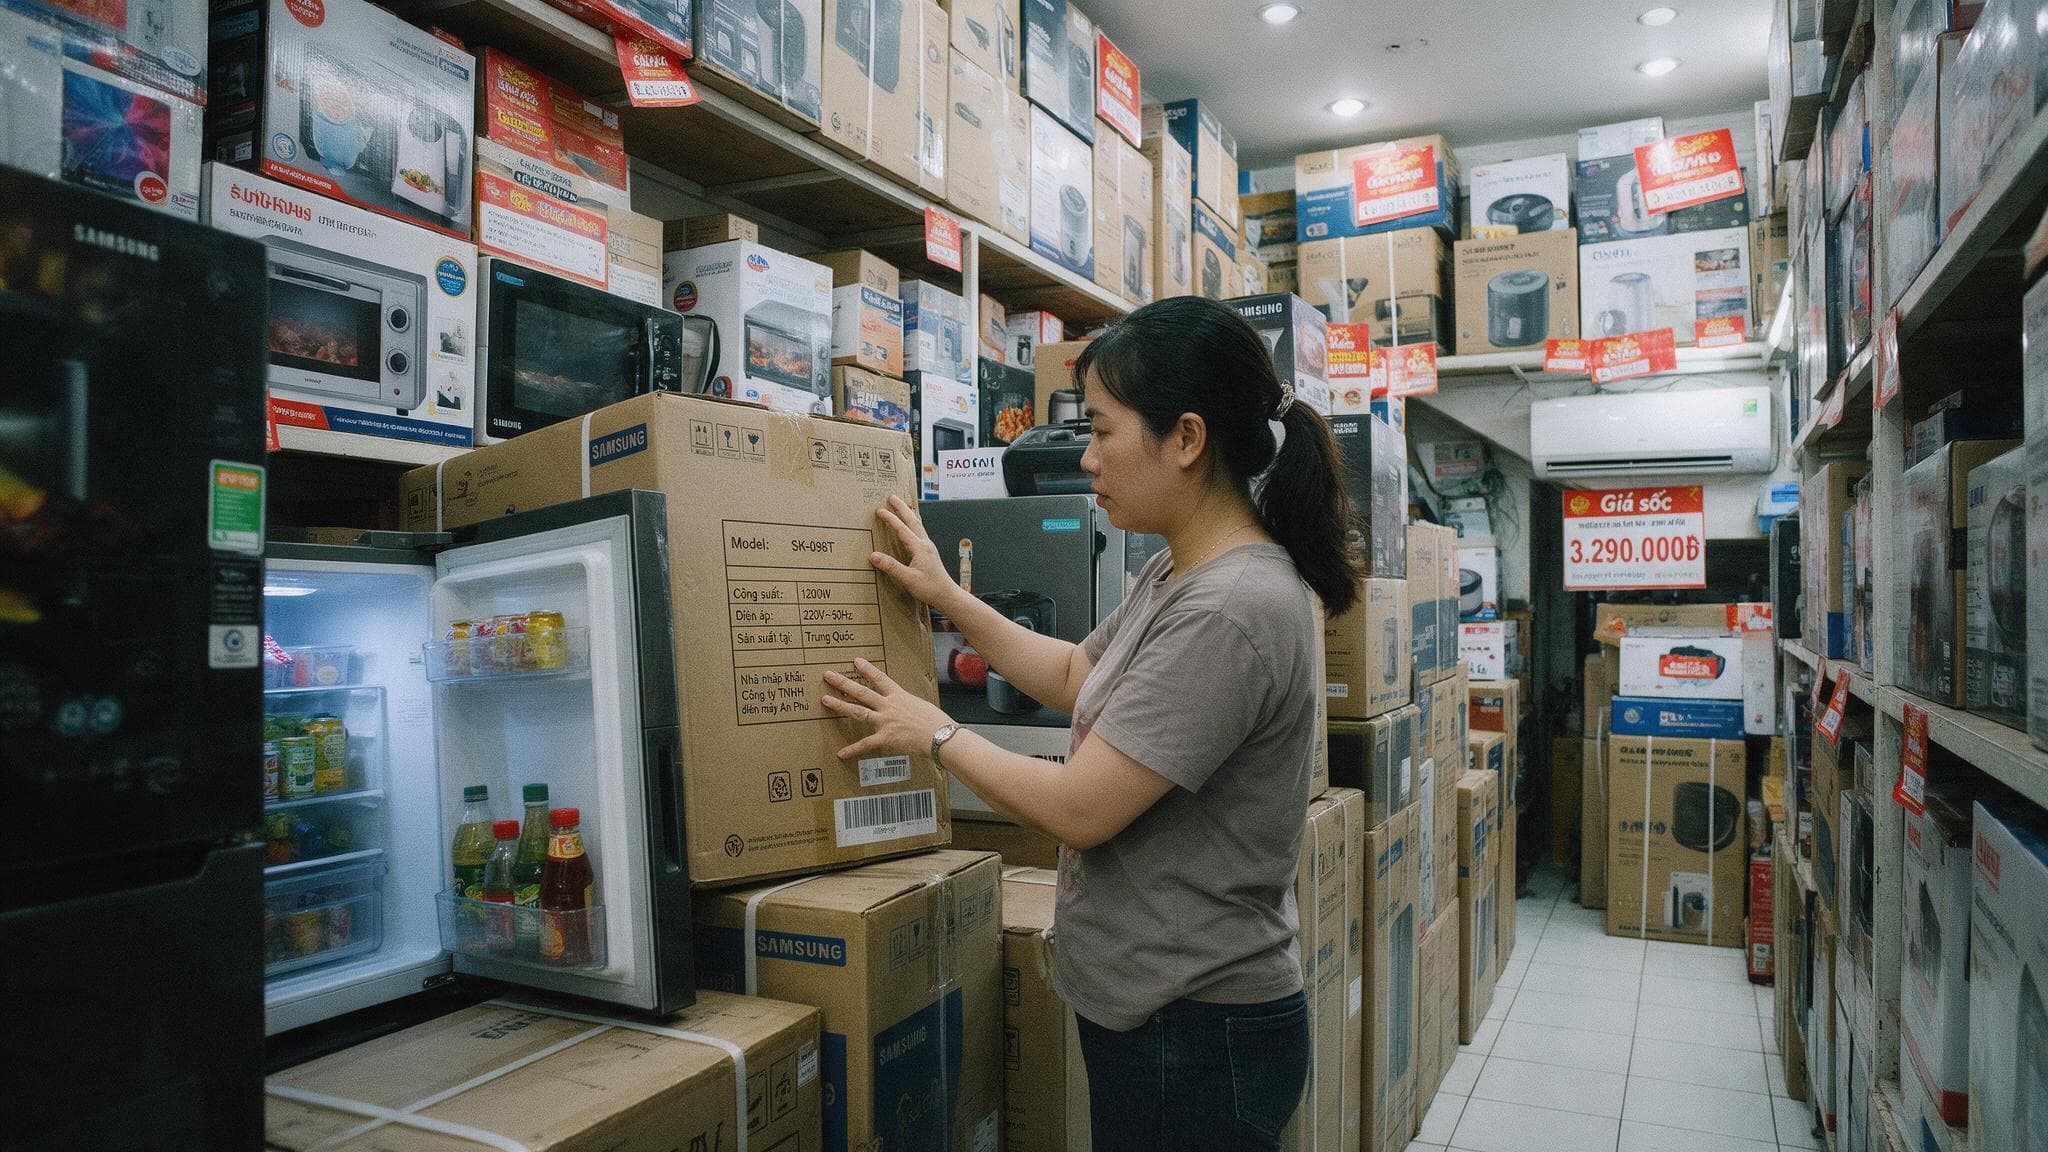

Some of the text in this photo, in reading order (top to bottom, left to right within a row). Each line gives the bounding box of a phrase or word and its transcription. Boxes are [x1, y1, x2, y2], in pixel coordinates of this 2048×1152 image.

[73, 223, 161, 262] SAMSUNG
[1236, 302, 1283, 318] AMSUNG
[591, 430, 646, 461] SAMSUNG
[1600, 489, 1673, 513] Giá sốc
[731, 536, 770, 551] Model:
[733, 587, 758, 602] Công
[805, 631, 831, 645] Trung
[778, 687, 805, 699] TNHH
[756, 935, 843, 960] SAMSUNG
